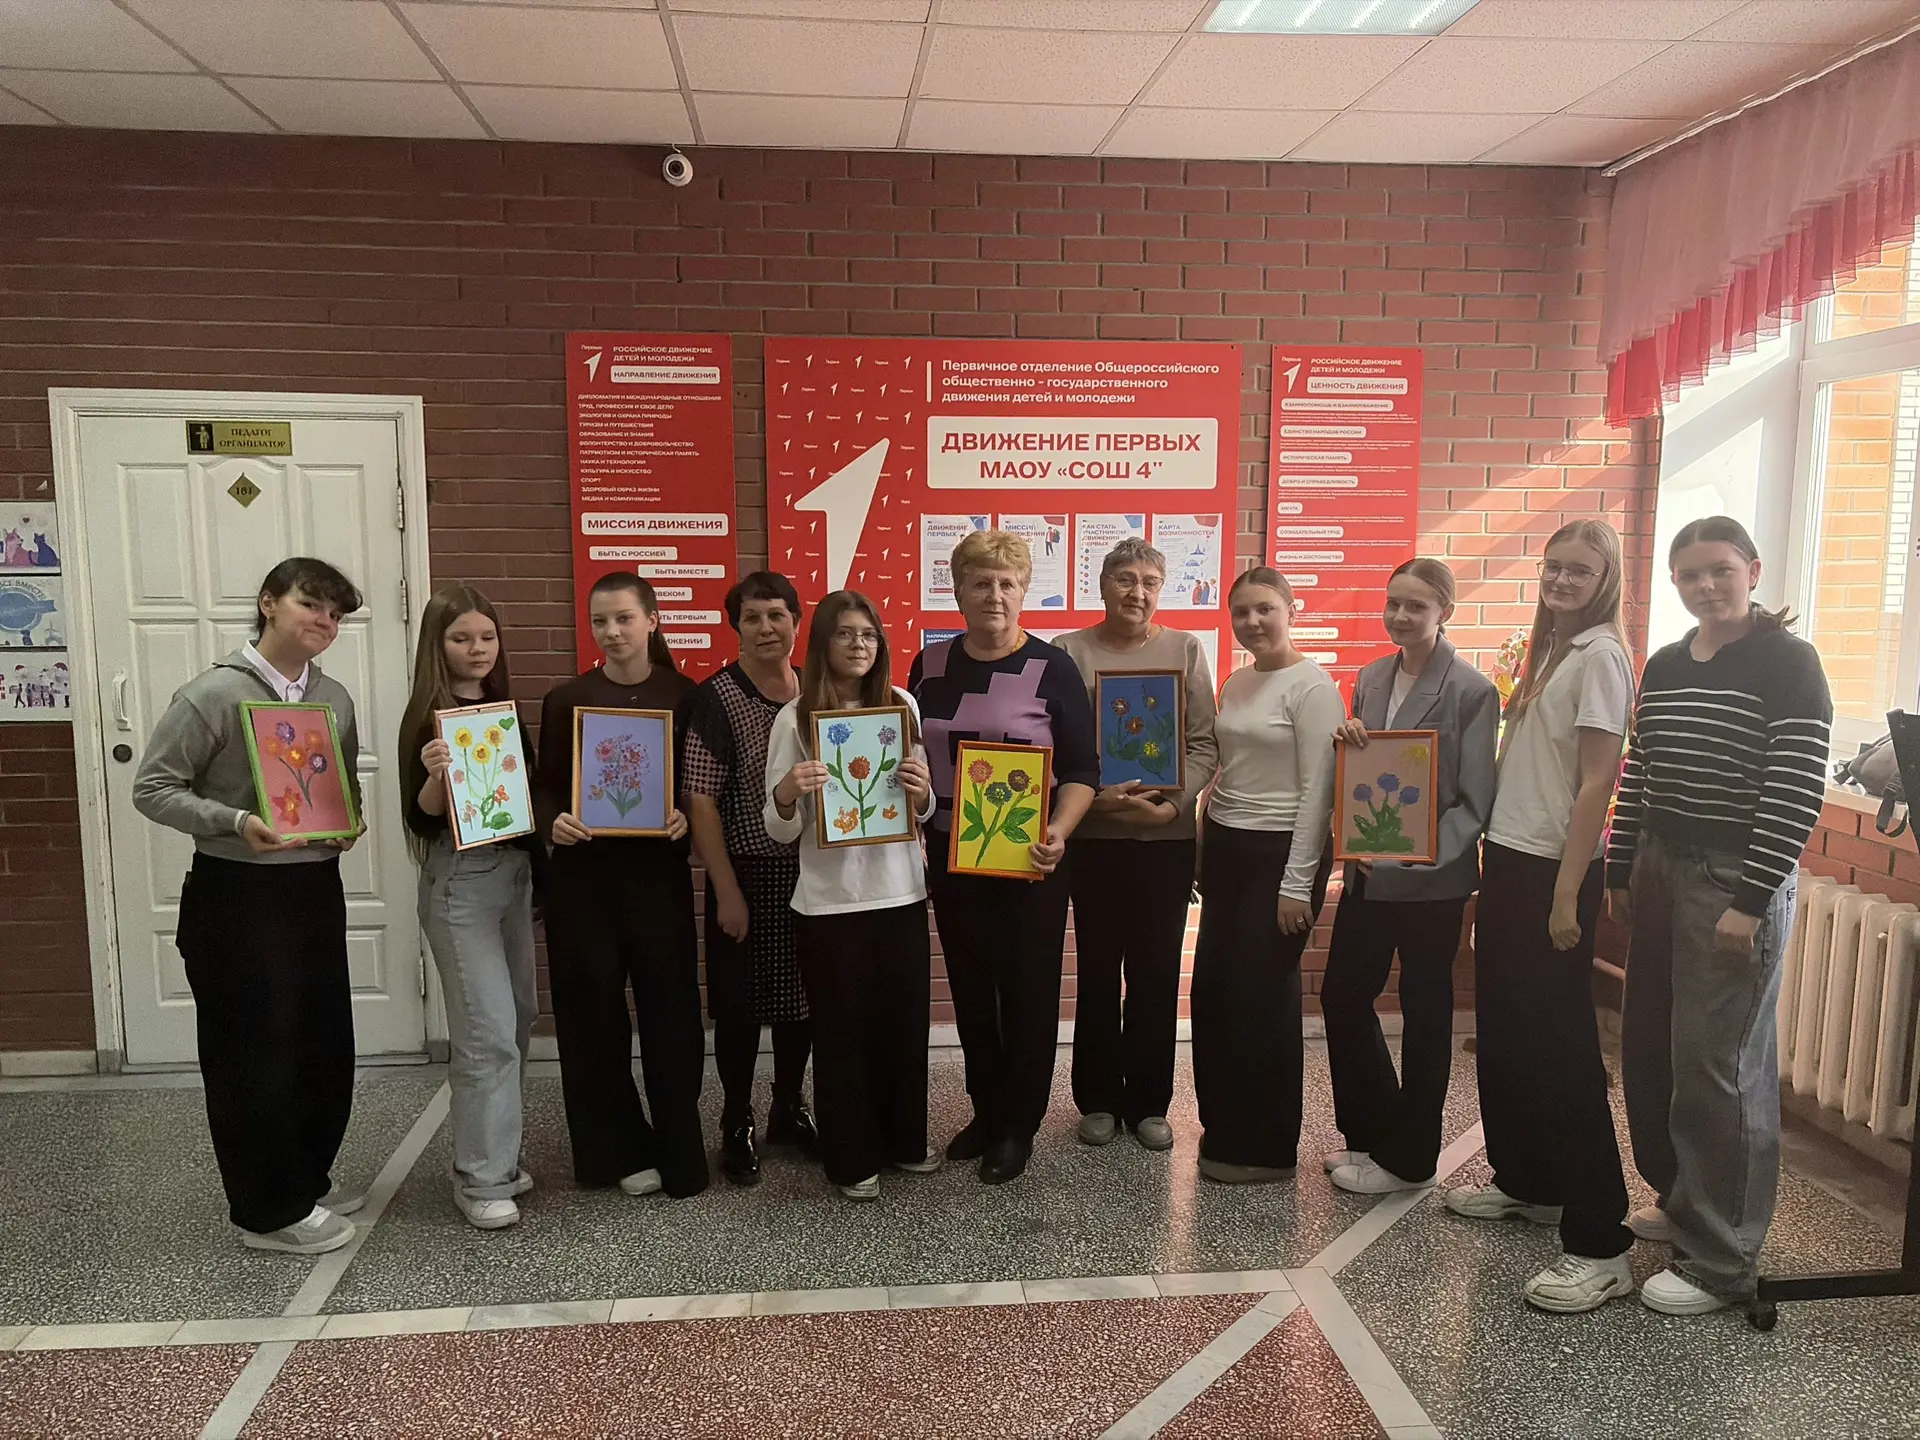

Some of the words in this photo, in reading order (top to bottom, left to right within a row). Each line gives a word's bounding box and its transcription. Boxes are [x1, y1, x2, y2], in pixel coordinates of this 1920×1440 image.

[942, 360, 1018, 373] Первичное
[1020, 362, 1092, 373] отделение
[1094, 362, 1220, 375] Общероссийского
[942, 376, 1036, 388] общественно
[1047, 378, 1168, 389] государственного
[942, 393, 1010, 403] движения
[1012, 392, 1052, 403] детей
[1066, 394, 1136, 404] молодежи
[231, 429, 272, 437] ПЕДАГОГ
[941, 432, 1090, 453] ДВИЖЕНИЕ
[1095, 434, 1202, 452] ПЕРВЫХ
[980, 461, 1052, 479] МАОУ
[1057, 462, 1130, 479] «СОШ
[588, 520, 645, 529] МИССИЯ
[648, 520, 723, 530] ДВИЖЕНИЯ
